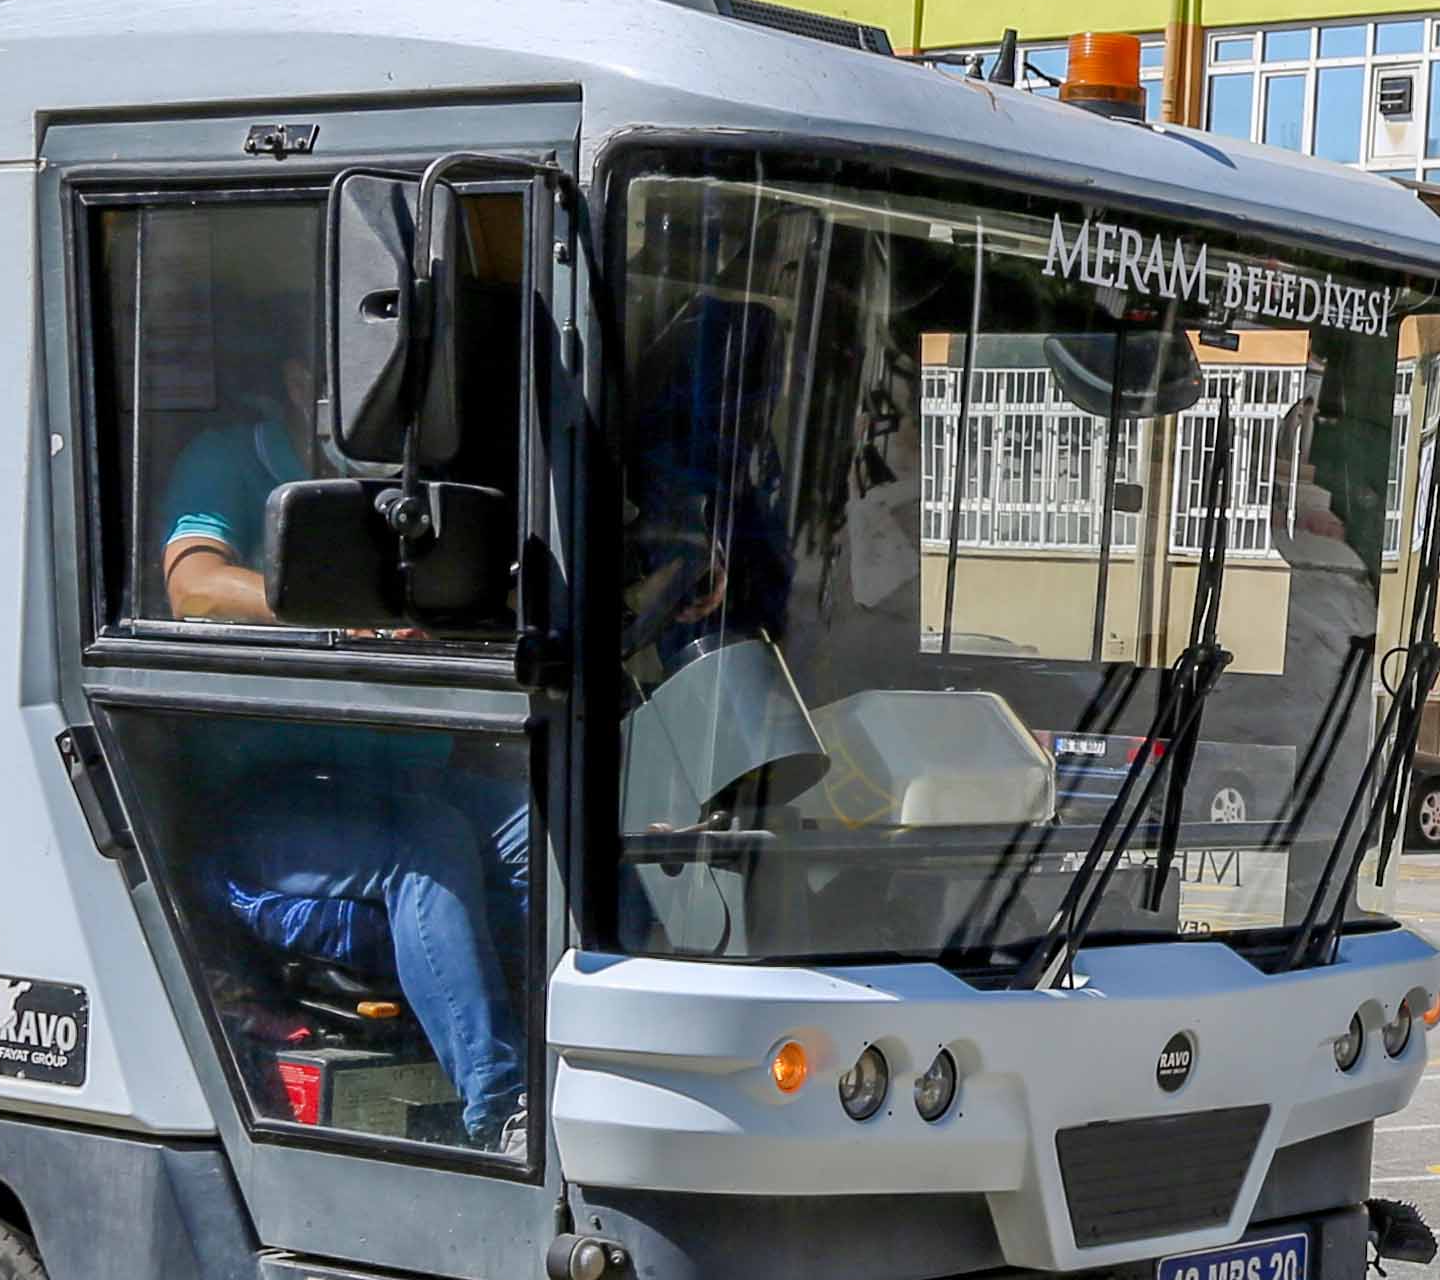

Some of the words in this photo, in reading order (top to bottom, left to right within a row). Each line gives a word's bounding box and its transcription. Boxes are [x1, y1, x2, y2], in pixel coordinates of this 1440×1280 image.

[1042, 213, 1209, 306] MERAM
[1225, 262, 1390, 337] BELEDİYESİ
[31, 1052, 68, 1067] GROUP
[1160, 1051, 1190, 1068] RAVO
